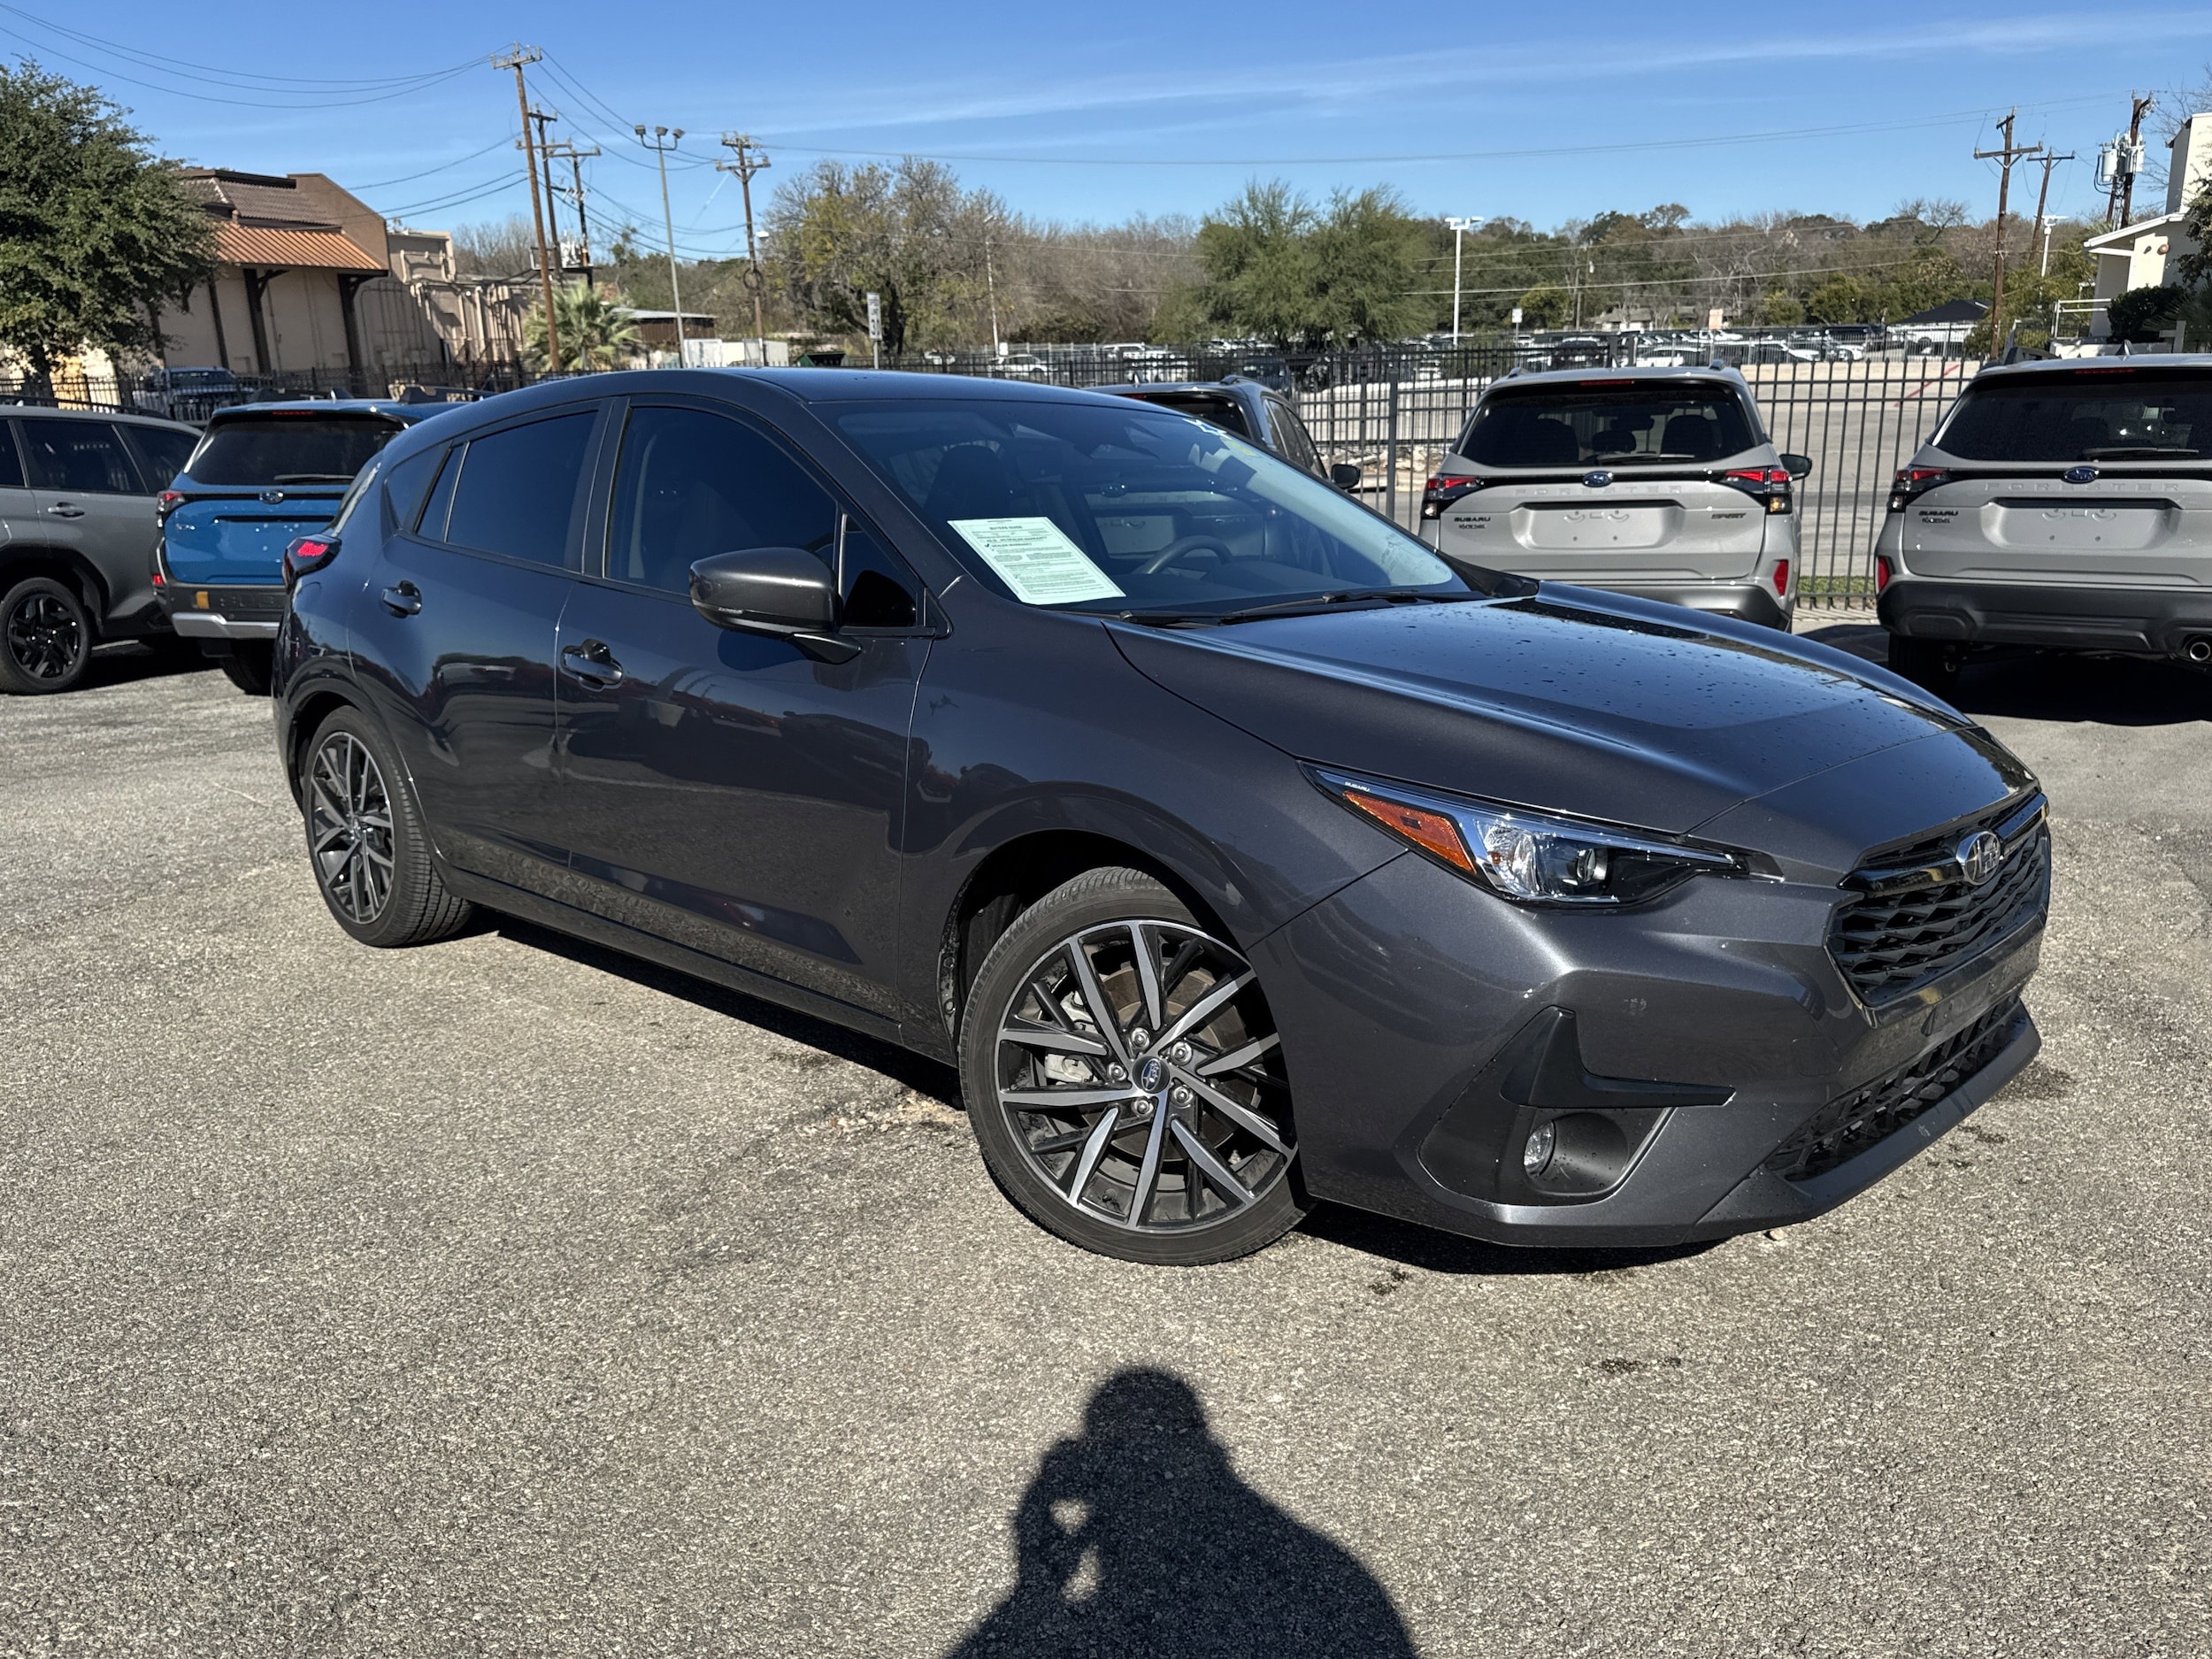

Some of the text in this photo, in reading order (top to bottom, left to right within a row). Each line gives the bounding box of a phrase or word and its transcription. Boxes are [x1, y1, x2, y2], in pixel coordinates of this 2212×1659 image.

[1514, 485, 1683, 496] FORESTER
[1983, 483, 2179, 492] FORESTER
[1345, 781, 1371, 791] SUBARU
